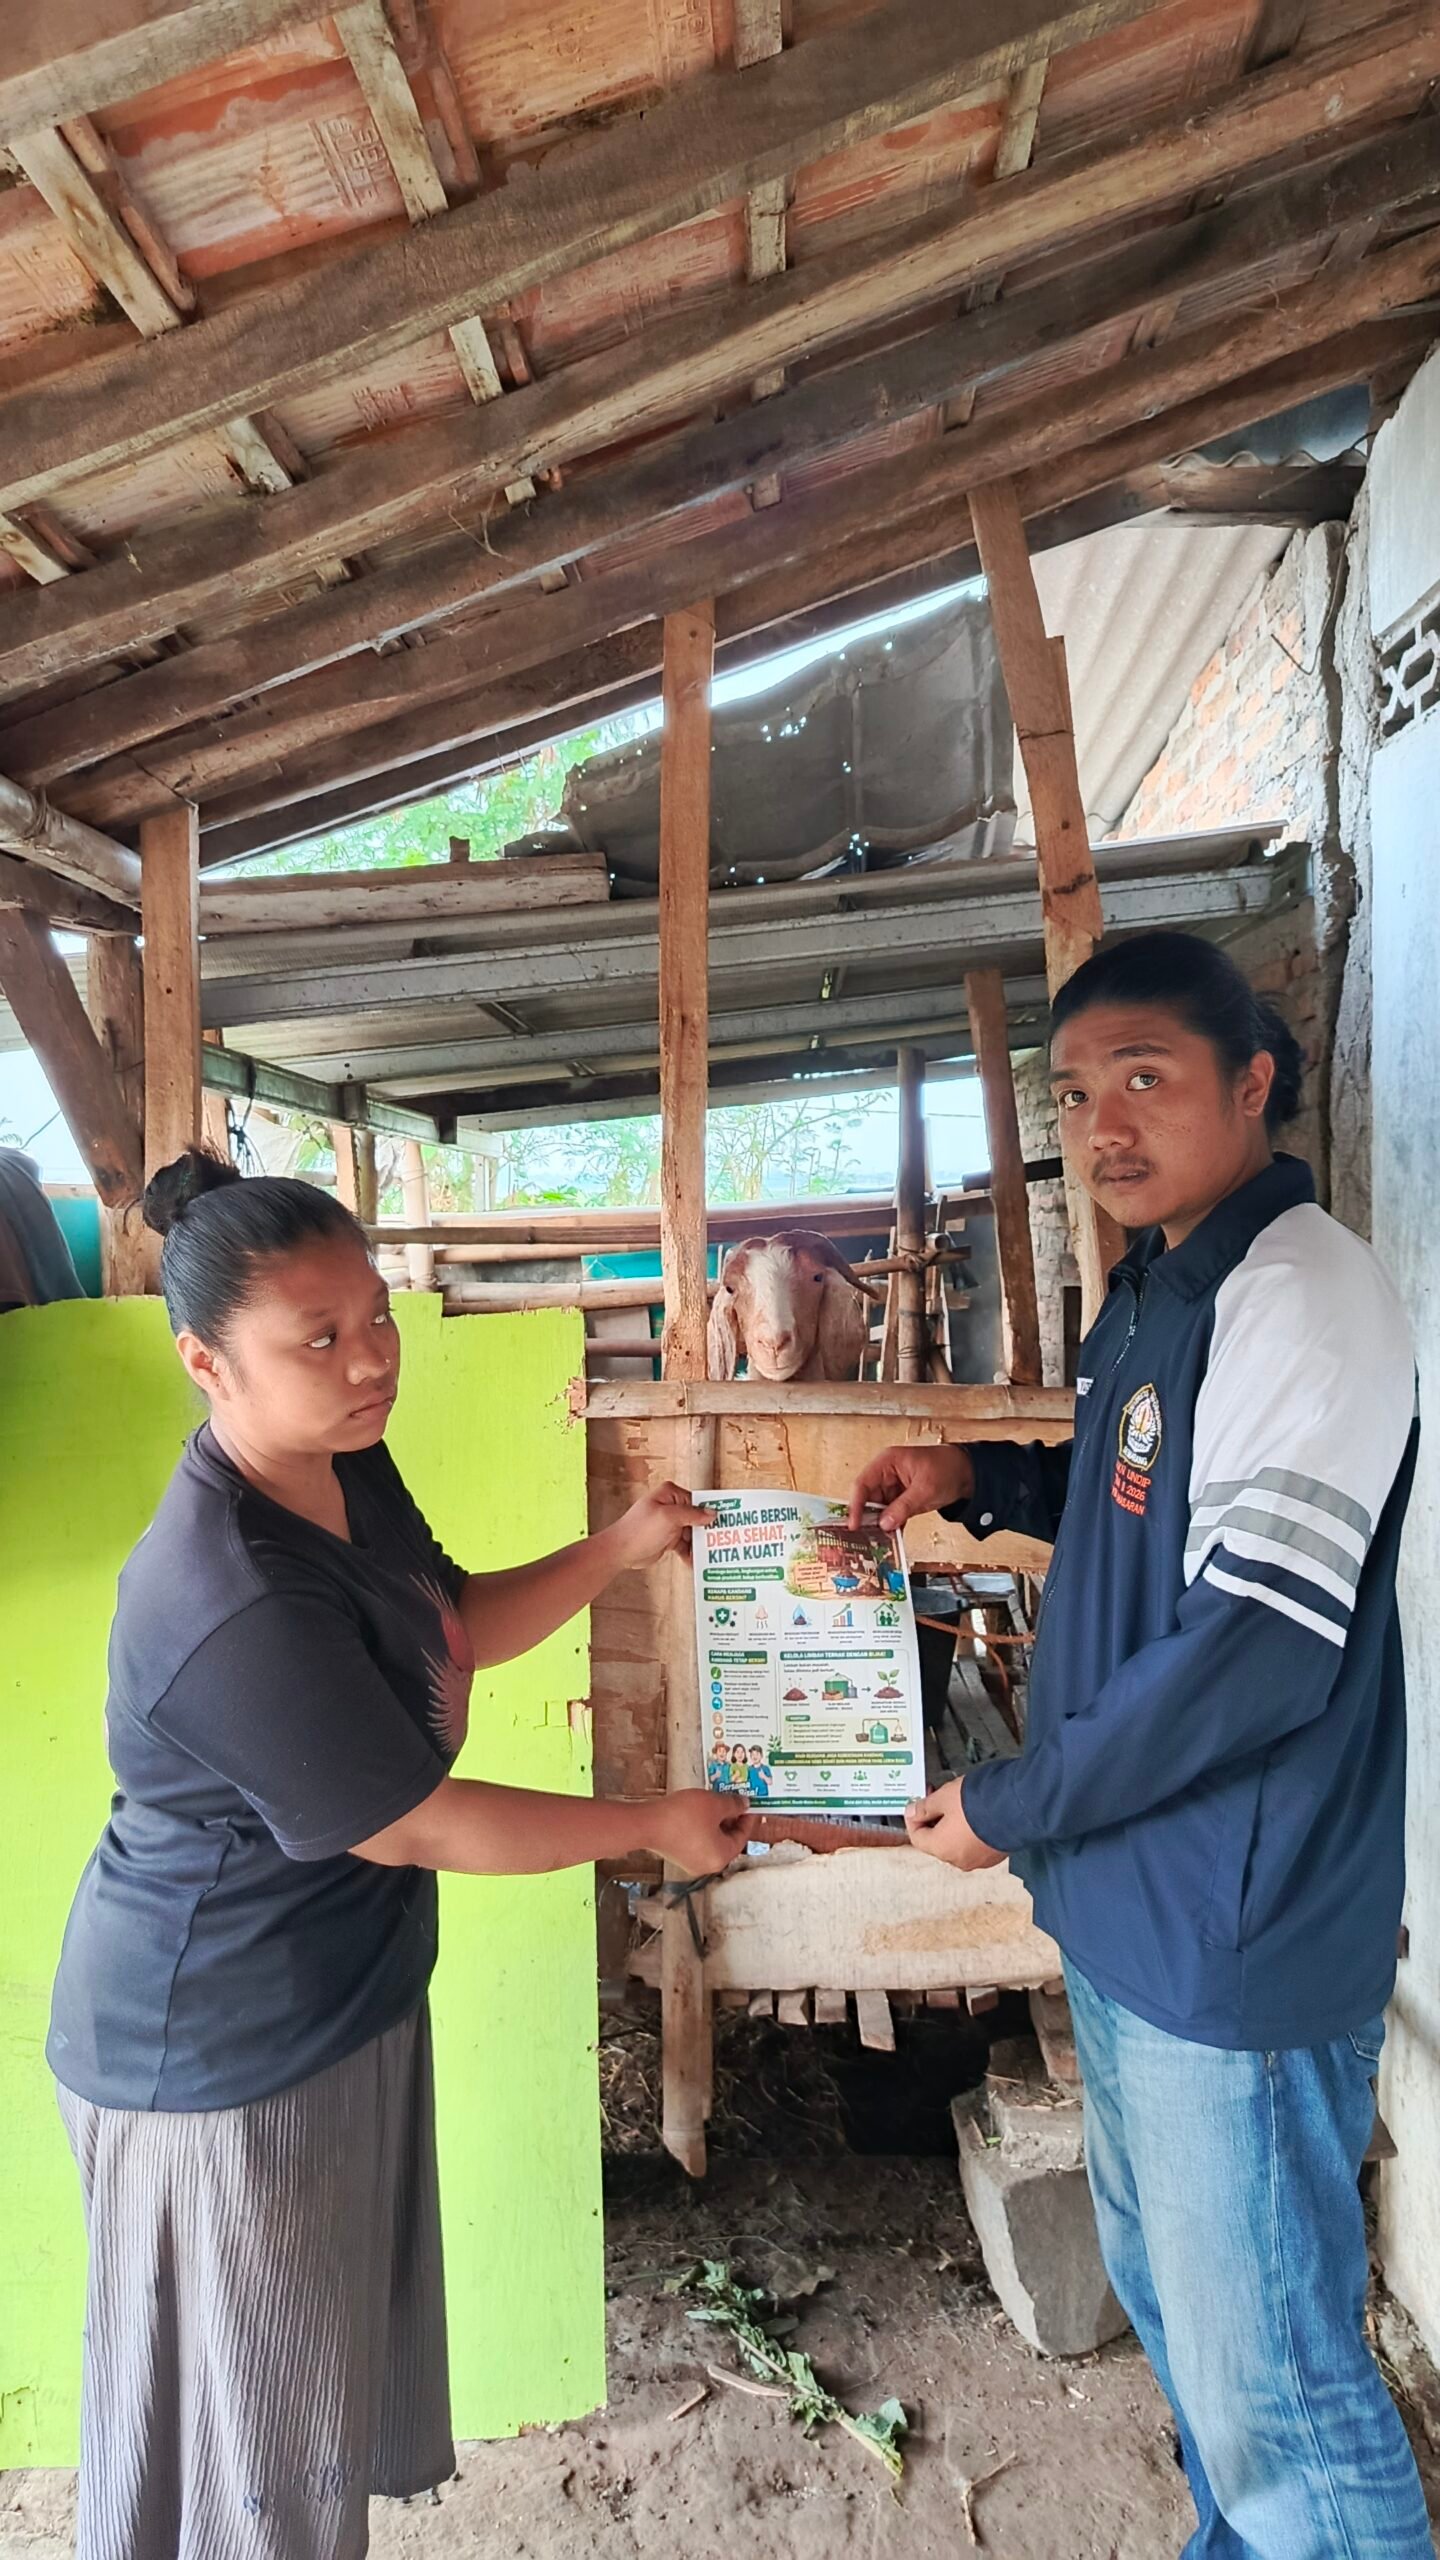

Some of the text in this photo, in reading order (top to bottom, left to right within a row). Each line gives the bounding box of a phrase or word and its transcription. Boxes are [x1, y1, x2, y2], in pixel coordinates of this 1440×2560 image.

[1126, 1469, 1151, 1488] UNDIP
[1126, 1485, 1146, 1501] 2026
[760, 1506, 802, 1524] BERSIH,
[706, 1525, 788, 1548] DESA SEHAT,
[708, 1543, 784, 1564] KITA KUAT!
